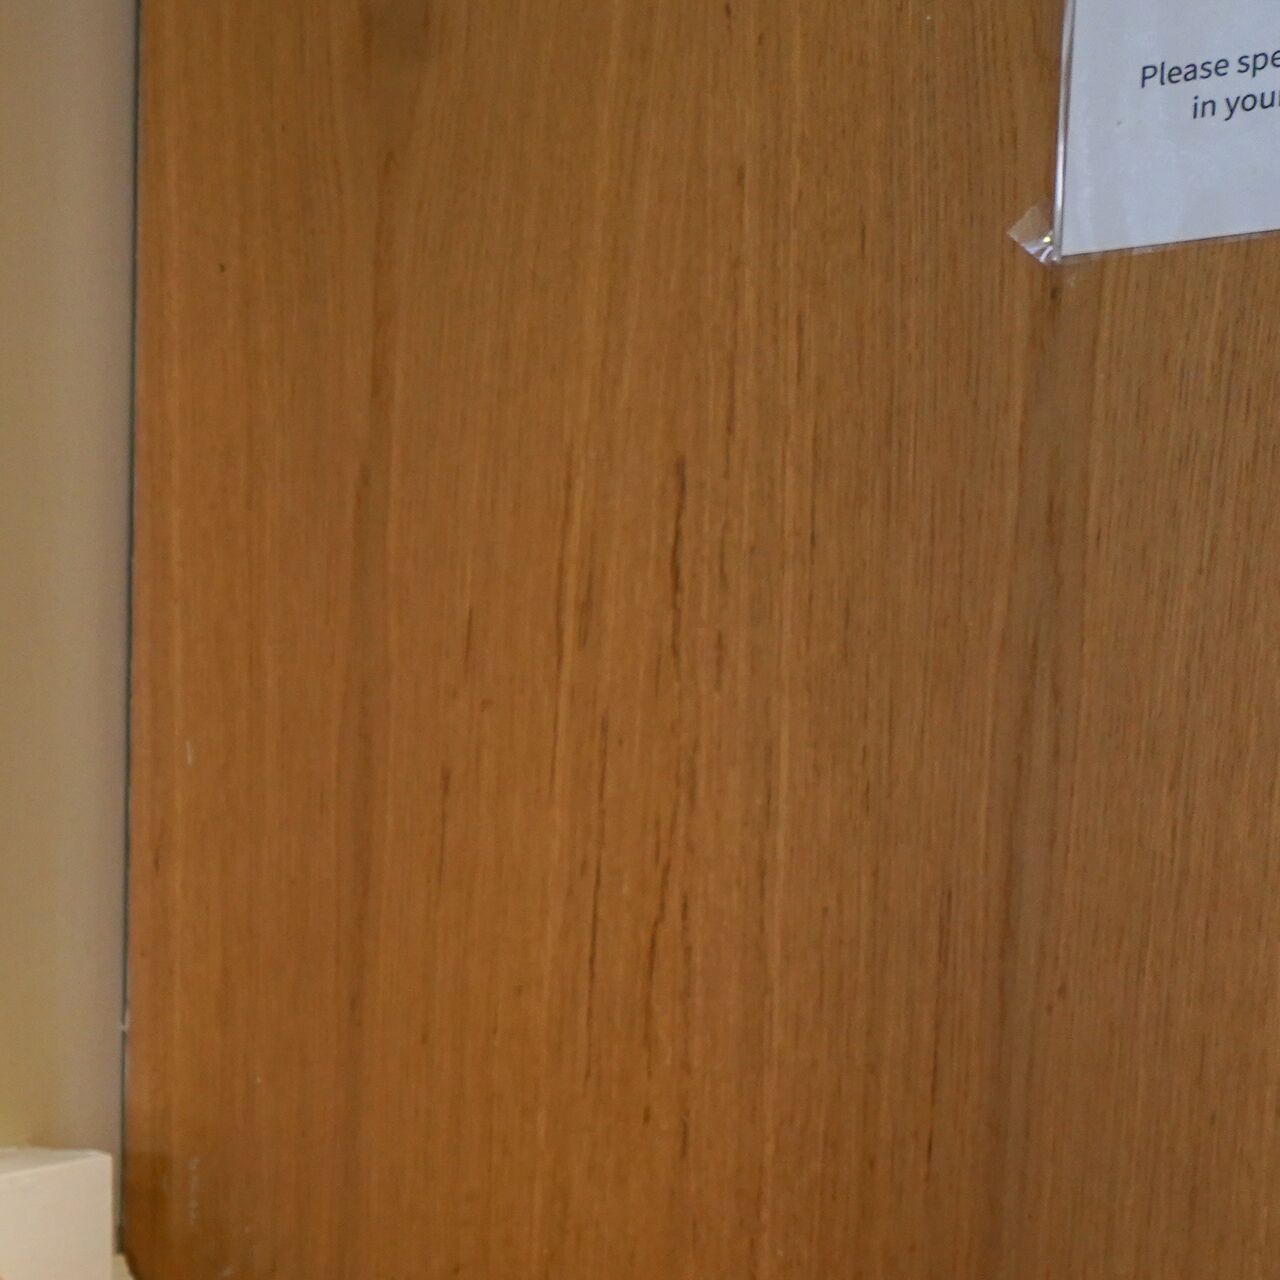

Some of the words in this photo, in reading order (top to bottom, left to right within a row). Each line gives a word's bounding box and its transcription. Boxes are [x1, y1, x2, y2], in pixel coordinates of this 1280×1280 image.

[1141, 58, 1230, 88] Please
[1192, 95, 1216, 120] in
[1224, 90, 1280, 121] you
